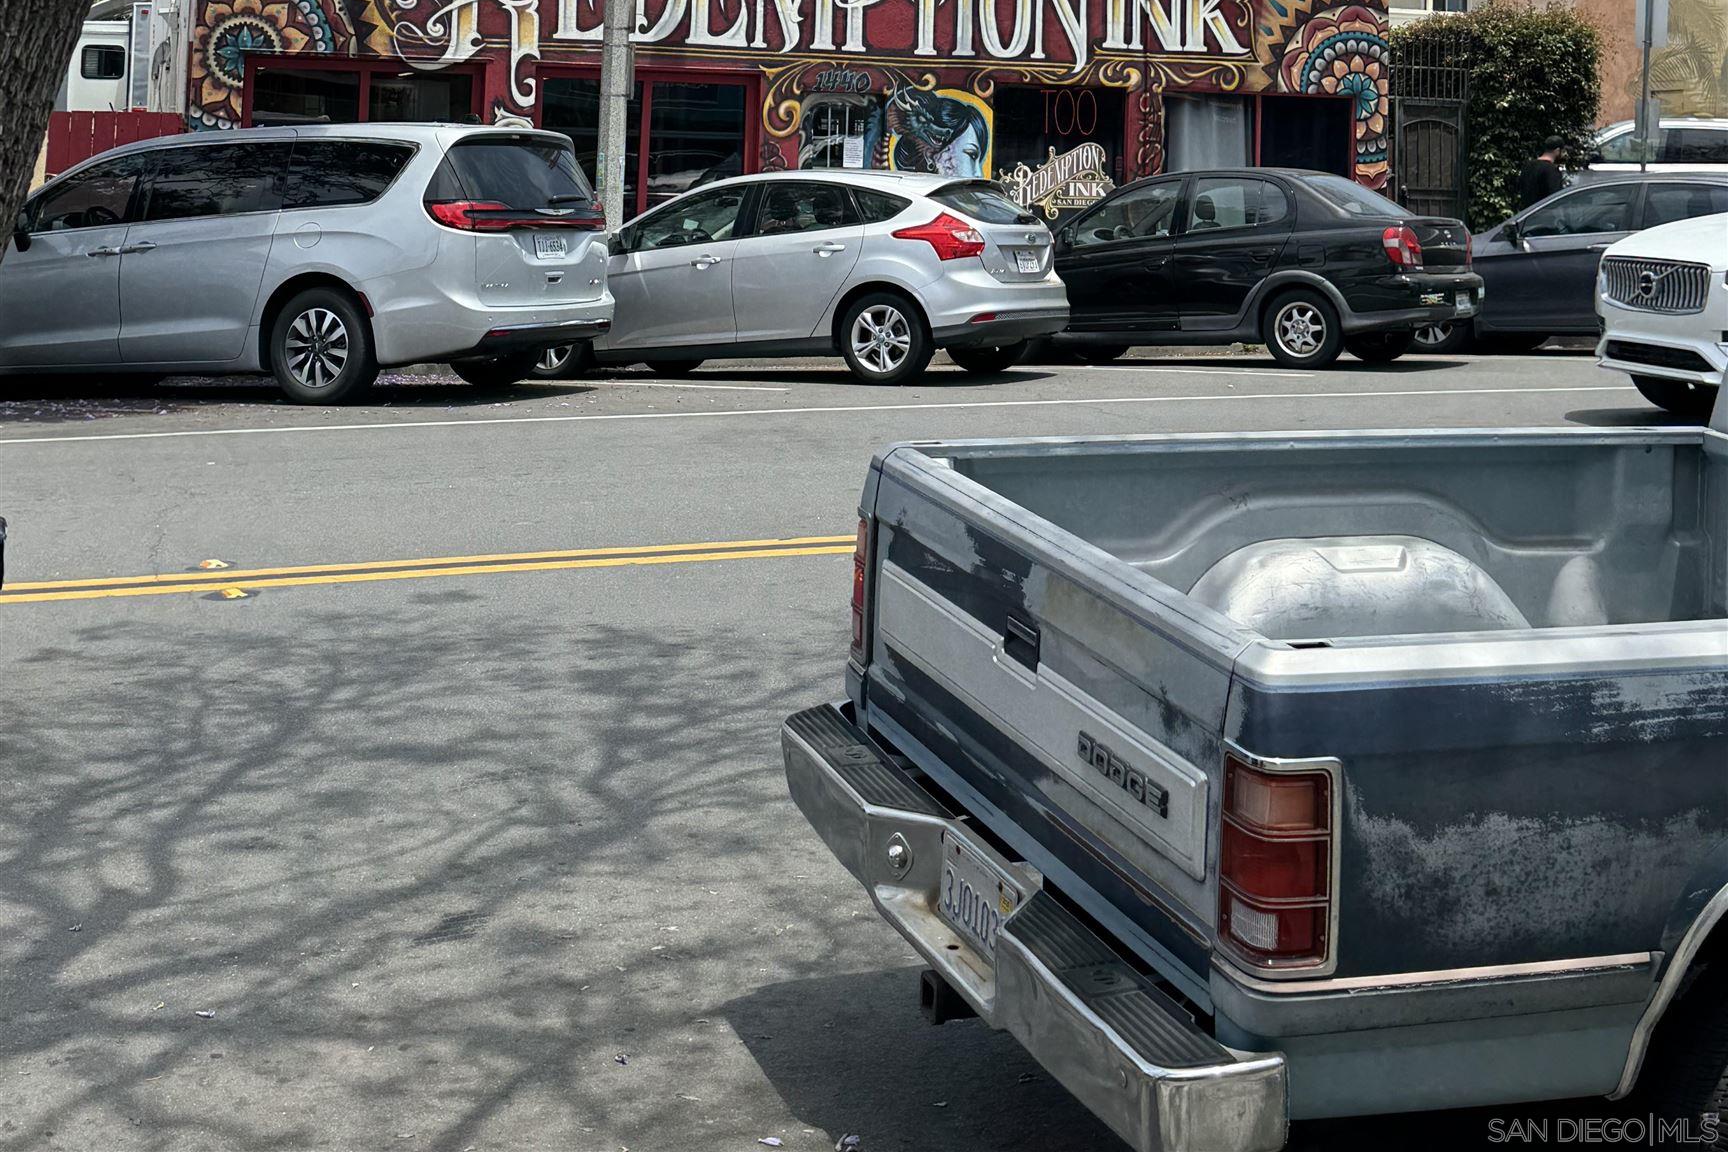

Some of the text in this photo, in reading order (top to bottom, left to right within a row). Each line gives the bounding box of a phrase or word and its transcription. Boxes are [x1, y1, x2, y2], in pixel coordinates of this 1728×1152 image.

[812, 69, 872, 94] 1440
[1040, 88, 1098, 136] TOO
[1010, 144, 1101, 213] REDEMPTION
[1068, 182, 1107, 198] INK
[1078, 730, 1169, 819] DODGE
